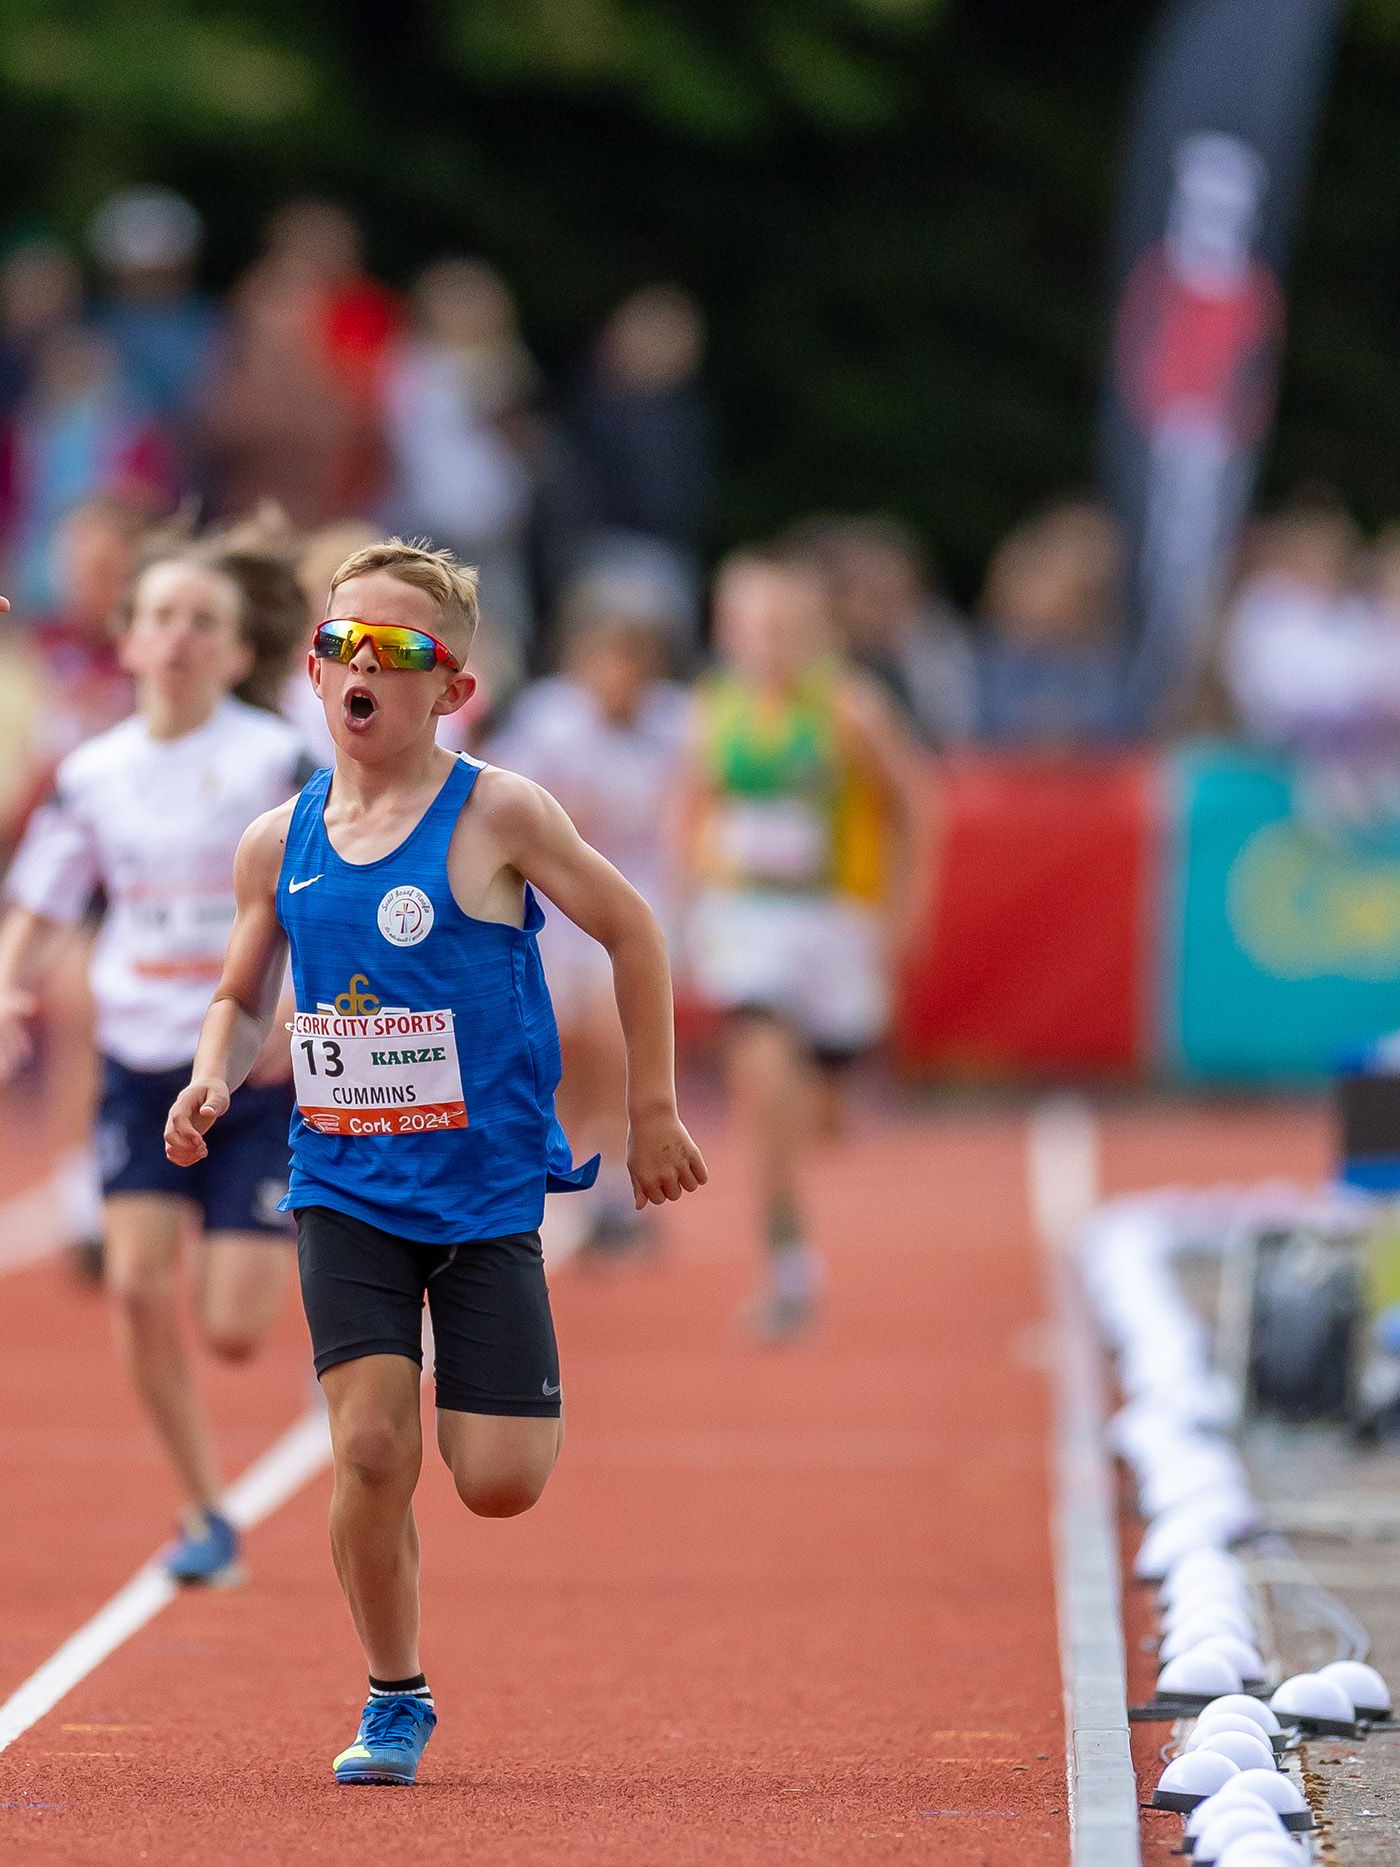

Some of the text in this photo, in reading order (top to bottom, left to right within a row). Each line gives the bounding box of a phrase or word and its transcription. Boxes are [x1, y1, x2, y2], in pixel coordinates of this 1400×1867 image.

[296, 1012, 446, 1037] CORK CITY SPORTS
[300, 1039, 344, 1077] 13
[371, 1047, 446, 1065] KARZE
[332, 1085, 416, 1104] CUMMINS
[349, 1114, 393, 1133] Cork
[399, 1112, 450, 1132] 2024
